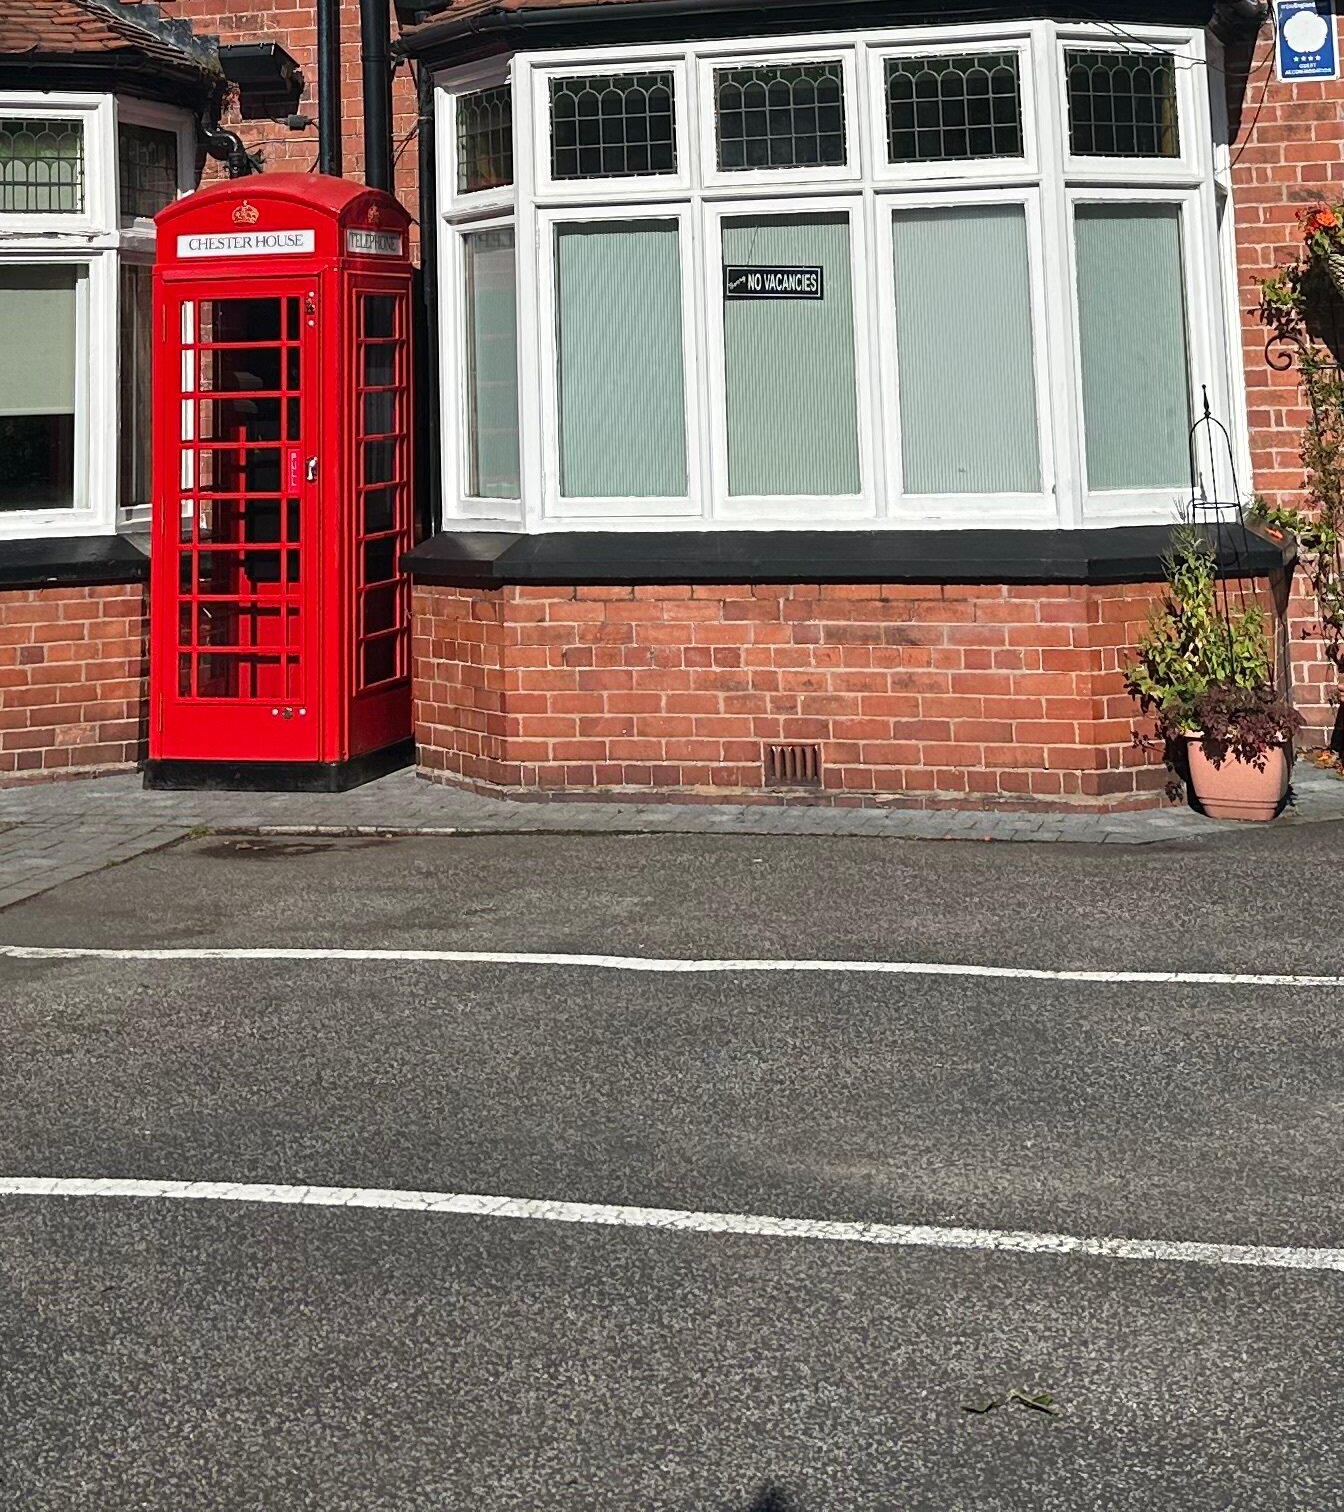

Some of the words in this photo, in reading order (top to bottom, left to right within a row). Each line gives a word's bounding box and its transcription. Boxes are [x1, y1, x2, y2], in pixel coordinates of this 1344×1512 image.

[188, 236, 253, 251] CHESTER
[255, 233, 305, 248] HOUSE
[349, 232, 401, 252] TELEPHONE
[747, 273, 762, 291] NO
[763, 273, 817, 292] VACANCIES
